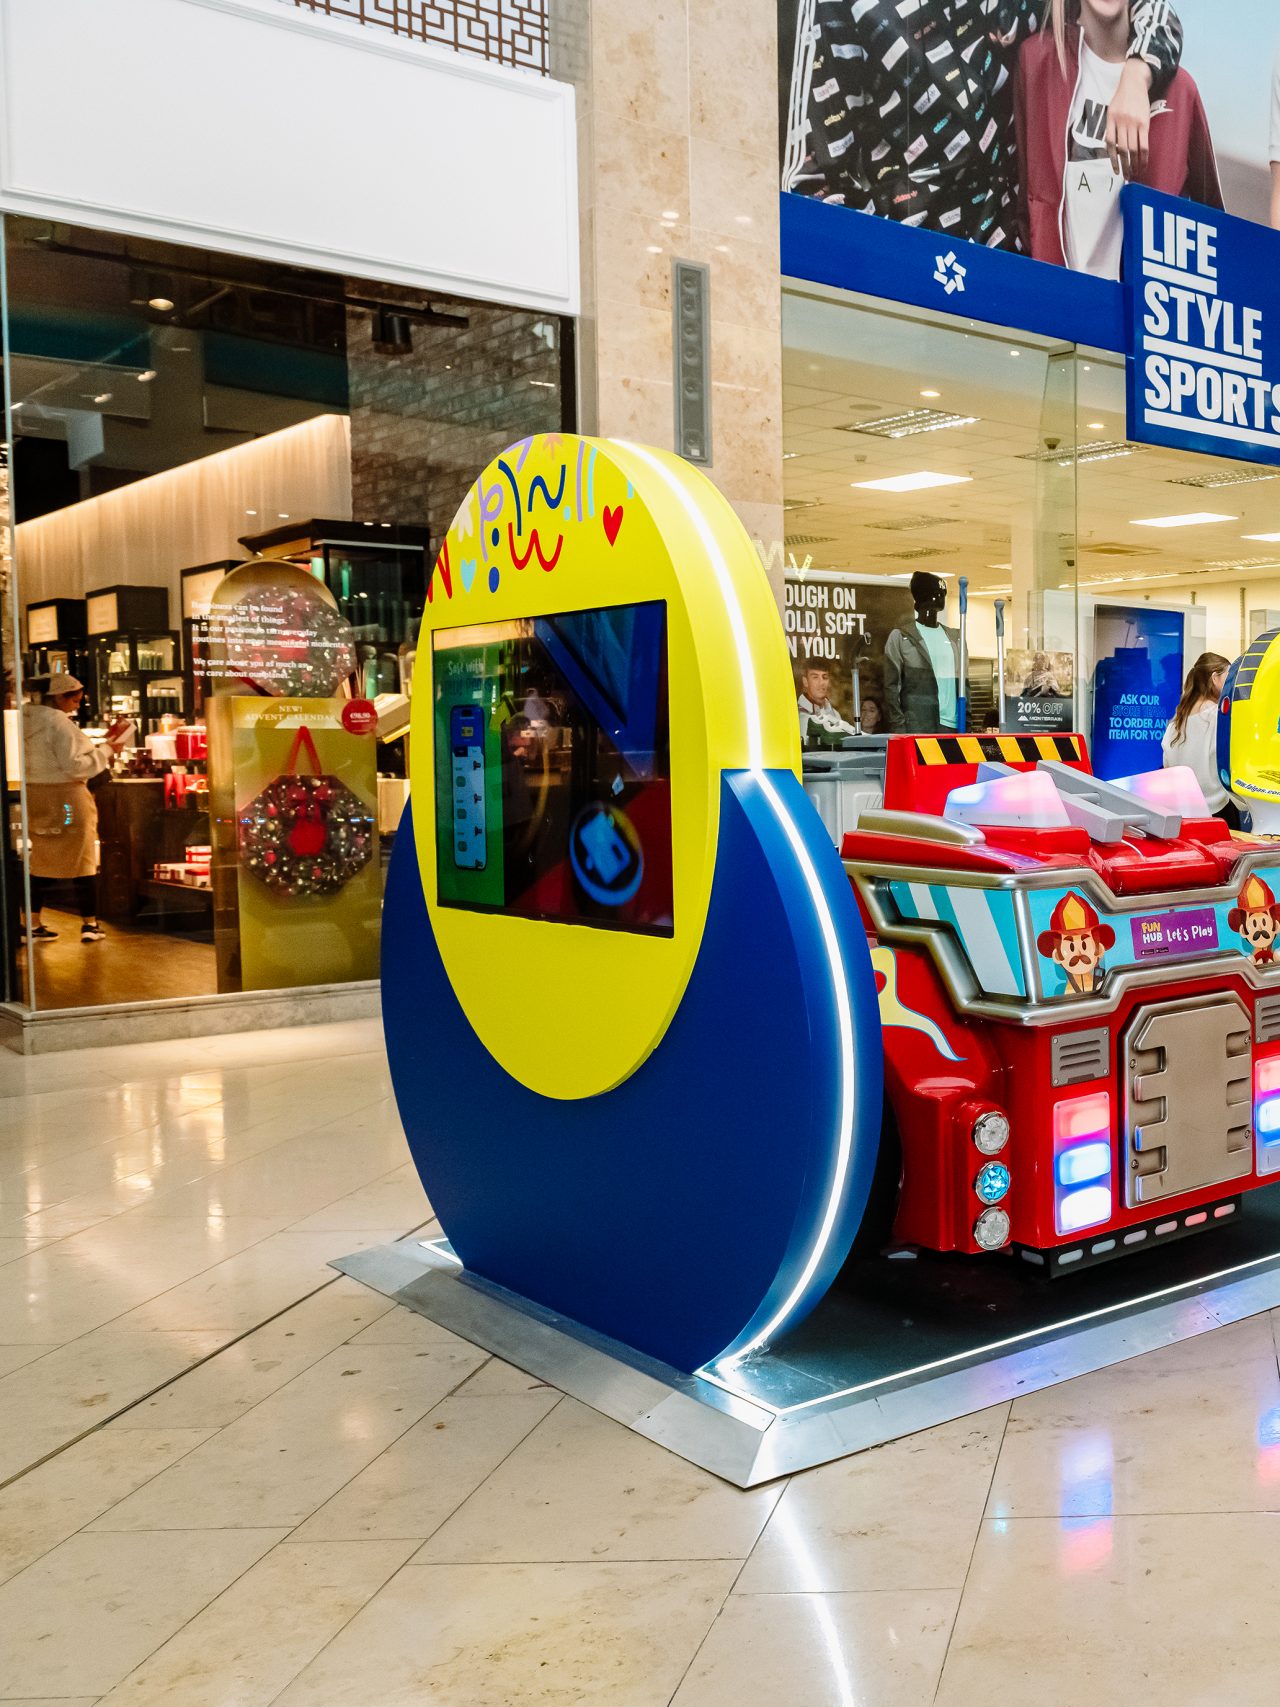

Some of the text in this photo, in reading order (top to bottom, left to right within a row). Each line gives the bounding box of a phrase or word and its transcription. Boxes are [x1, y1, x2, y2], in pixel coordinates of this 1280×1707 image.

[1076, 99, 1110, 141] NI
[1142, 204, 1217, 278] LIFE
[1144, 280, 1262, 360] STYLE
[785, 584, 856, 610] OUGH ON
[261, 605, 283, 613] found
[251, 615, 260, 623] of
[785, 610, 867, 636] OLD, SOFT
[787, 636, 841, 660] N YOU.
[208, 658, 224, 666] care
[226, 658, 248, 667] about
[249, 661, 264, 669] you
[275, 660, 296, 668] much
[225, 669, 247, 678] about
[1120, 694, 1160, 706] ASK OUR
[279, 705, 303, 713] NEW!
[1017, 702, 1063, 715] 20% OFF
[246, 713, 286, 721] ADVENT
[1109, 717, 1122, 728] TO
[1123, 717, 1153, 729] ORDER
[1109, 729, 1129, 740] ITEM
[1130, 729, 1147, 740] FOR
[1142, 922, 1213, 943] FUN Let's Play
[1143, 932, 1163, 944] HUB
